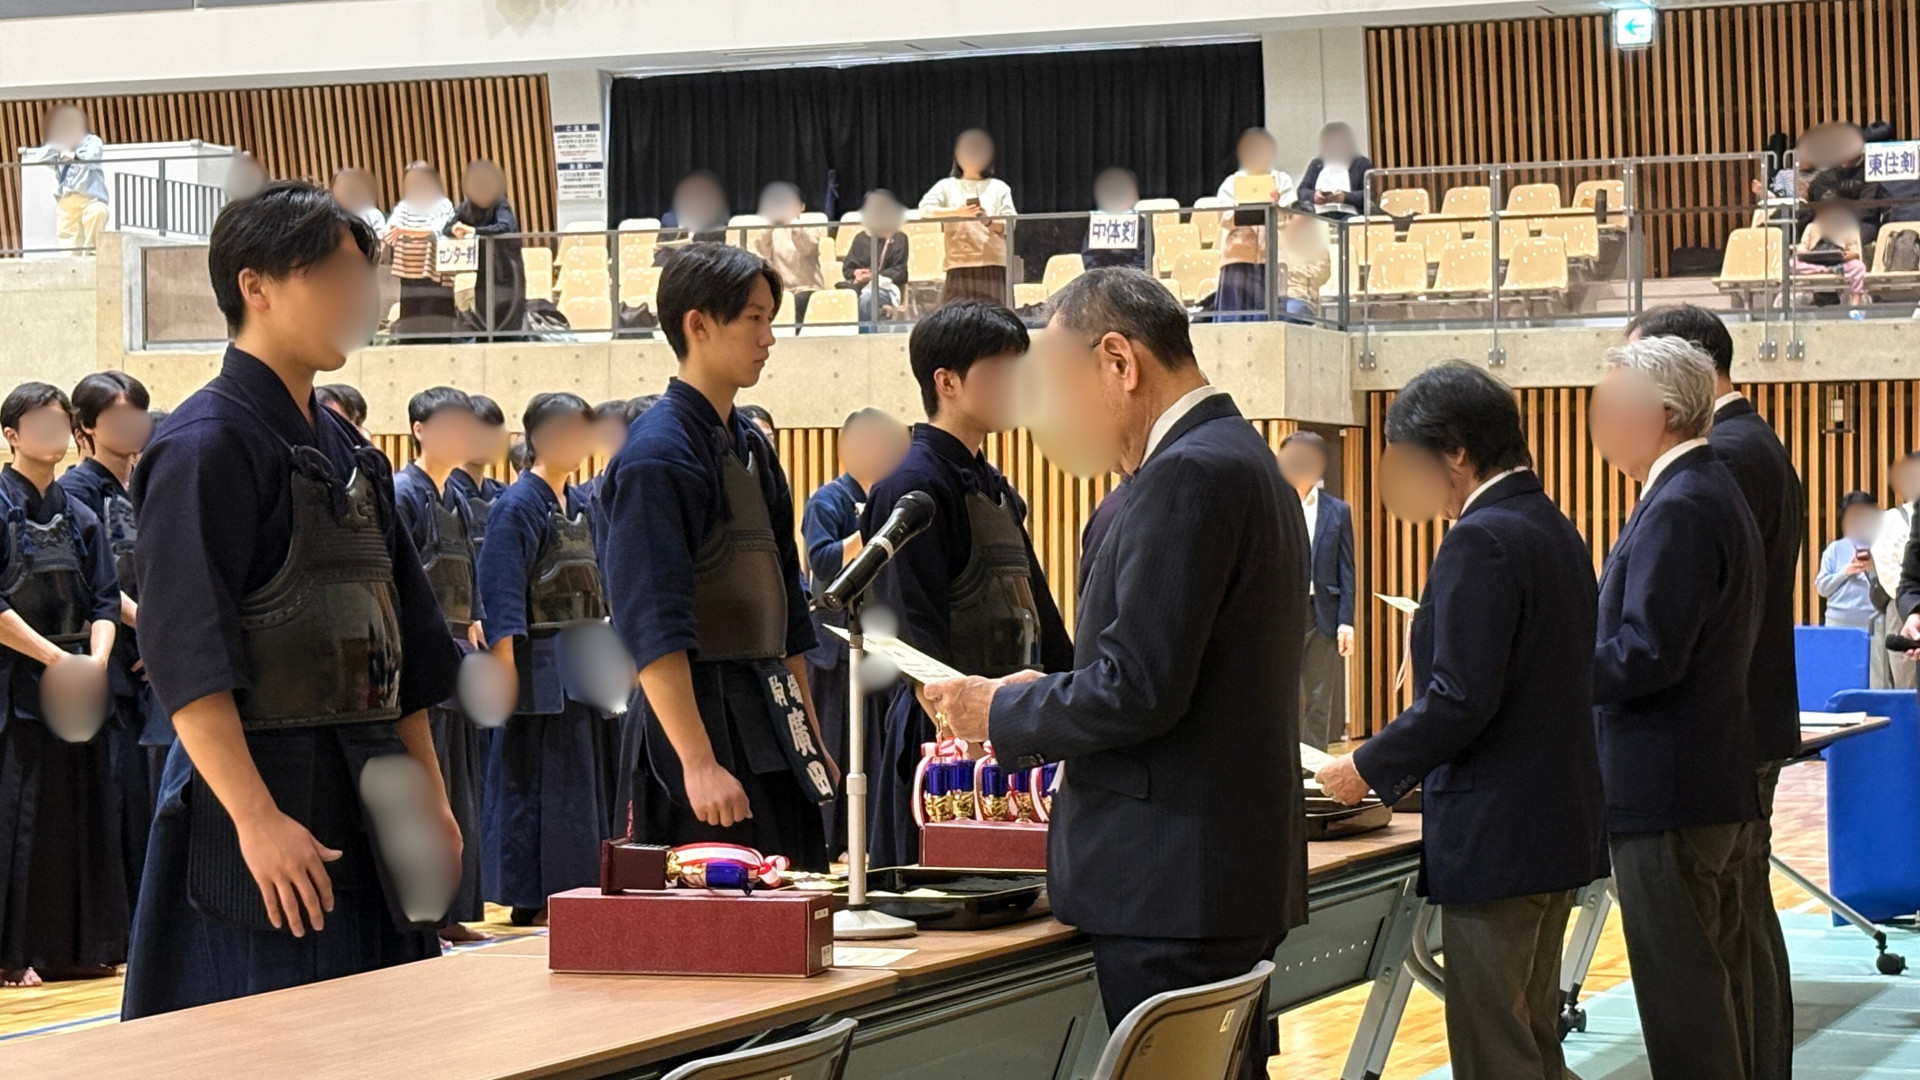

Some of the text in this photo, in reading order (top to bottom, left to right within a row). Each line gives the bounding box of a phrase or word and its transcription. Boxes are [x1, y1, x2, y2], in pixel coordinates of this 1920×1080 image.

[1868, 151, 1916, 176] 東住剣
[1092, 218, 1137, 244] 中体剣
